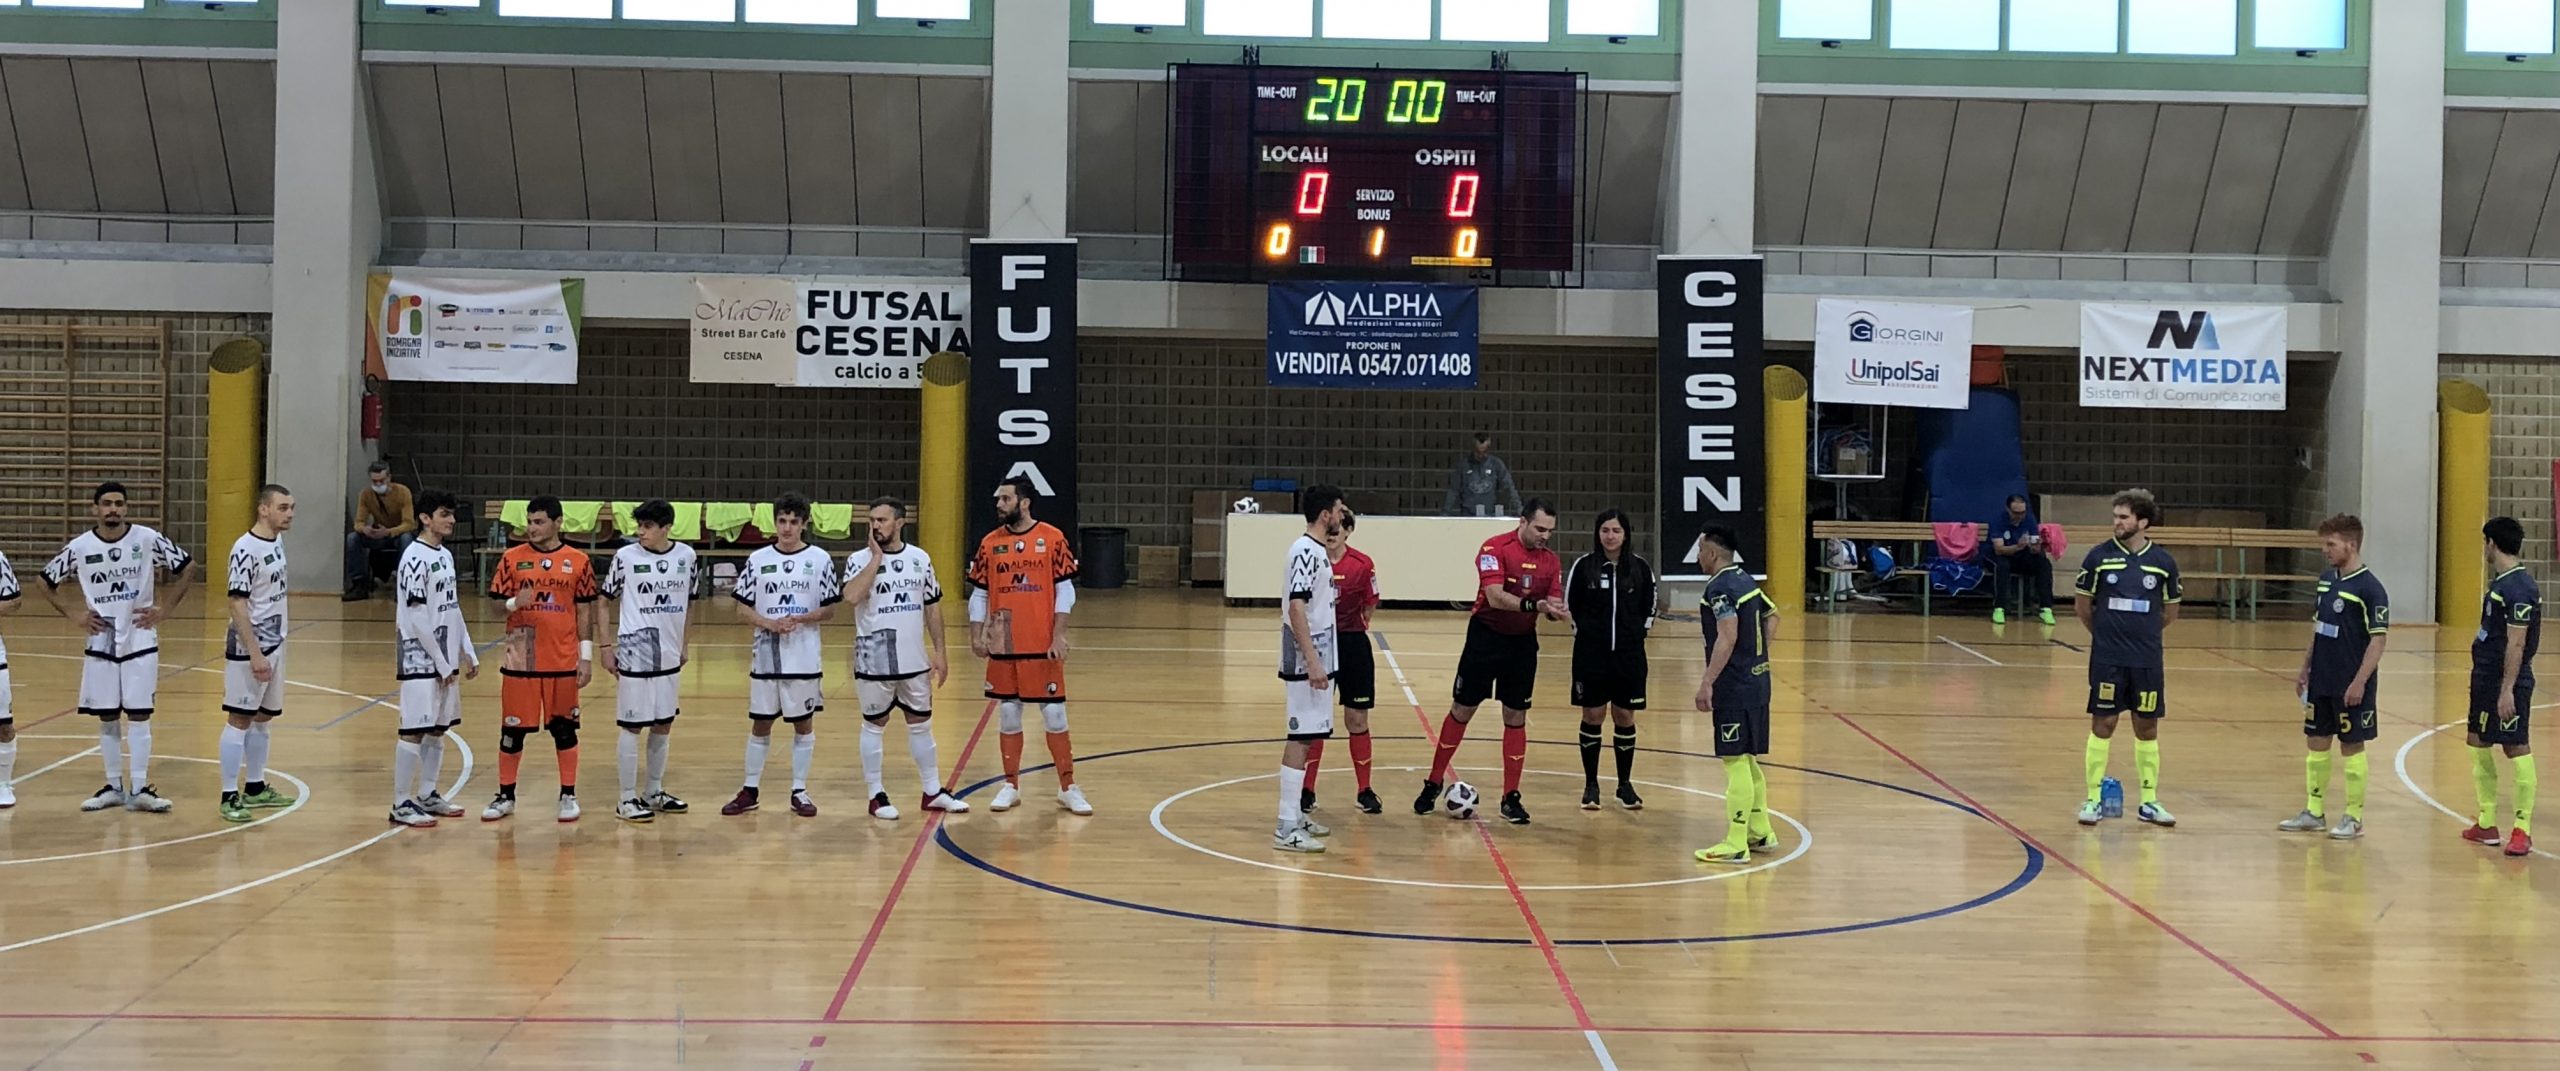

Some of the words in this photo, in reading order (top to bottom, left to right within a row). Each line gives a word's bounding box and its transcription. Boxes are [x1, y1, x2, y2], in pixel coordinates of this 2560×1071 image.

[1257, 86, 1297, 99] TIME-OUT
[1306, 79, 1366, 122] 20
[1386, 80, 1446, 123] 00
[1456, 90, 1496, 104] TIME-OUT
[1262, 146, 1328, 163] LOCALI
[1415, 149, 1476, 166] OSPITI
[1298, 172, 1329, 214] 0
[1356, 189, 1395, 202] SERVIZIO
[1448, 175, 1479, 217] 0
[1357, 209, 1391, 221] BONUS
[1268, 224, 1293, 256] 0
[1373, 227, 1385, 256] 1
[1456, 229, 1478, 257] 0
[808, 290, 962, 321] FUTSAL
[1348, 292, 1442, 316] ALPHA
[702, 328, 736, 339] Street
[739, 329, 760, 339] Bar
[796, 326, 970, 357] CESENA
[1852, 323, 1943, 342] GIORGINI
[386, 337, 422, 348] ROMAGNA
[1346, 342, 1389, 350] PROPONE
[1391, 342, 1401, 350] IN
[386, 348, 421, 358] INIZIATIVE
[724, 352, 762, 361] CESENA
[835, 363, 891, 379] calcio
[899, 367, 909, 379] a
[1275, 352, 1353, 375] VENDITA
[1359, 354, 1471, 376] 0547.071408
[1852, 358, 1940, 386] UnipolSai
[2084, 356, 2281, 384] NEXTMEDIA
[993, 255, 1056, 496] FUTSA
[2086, 387, 2139, 400] Sistemi
[2145, 388, 2158, 400] di
[2164, 389, 2280, 402] Comunicazione
[653, 580, 685, 590] ALPHA
[778, 580, 810, 590] ALPHA
[2137, 691, 2158, 712] 10
[2339, 713, 2351, 733] 5
